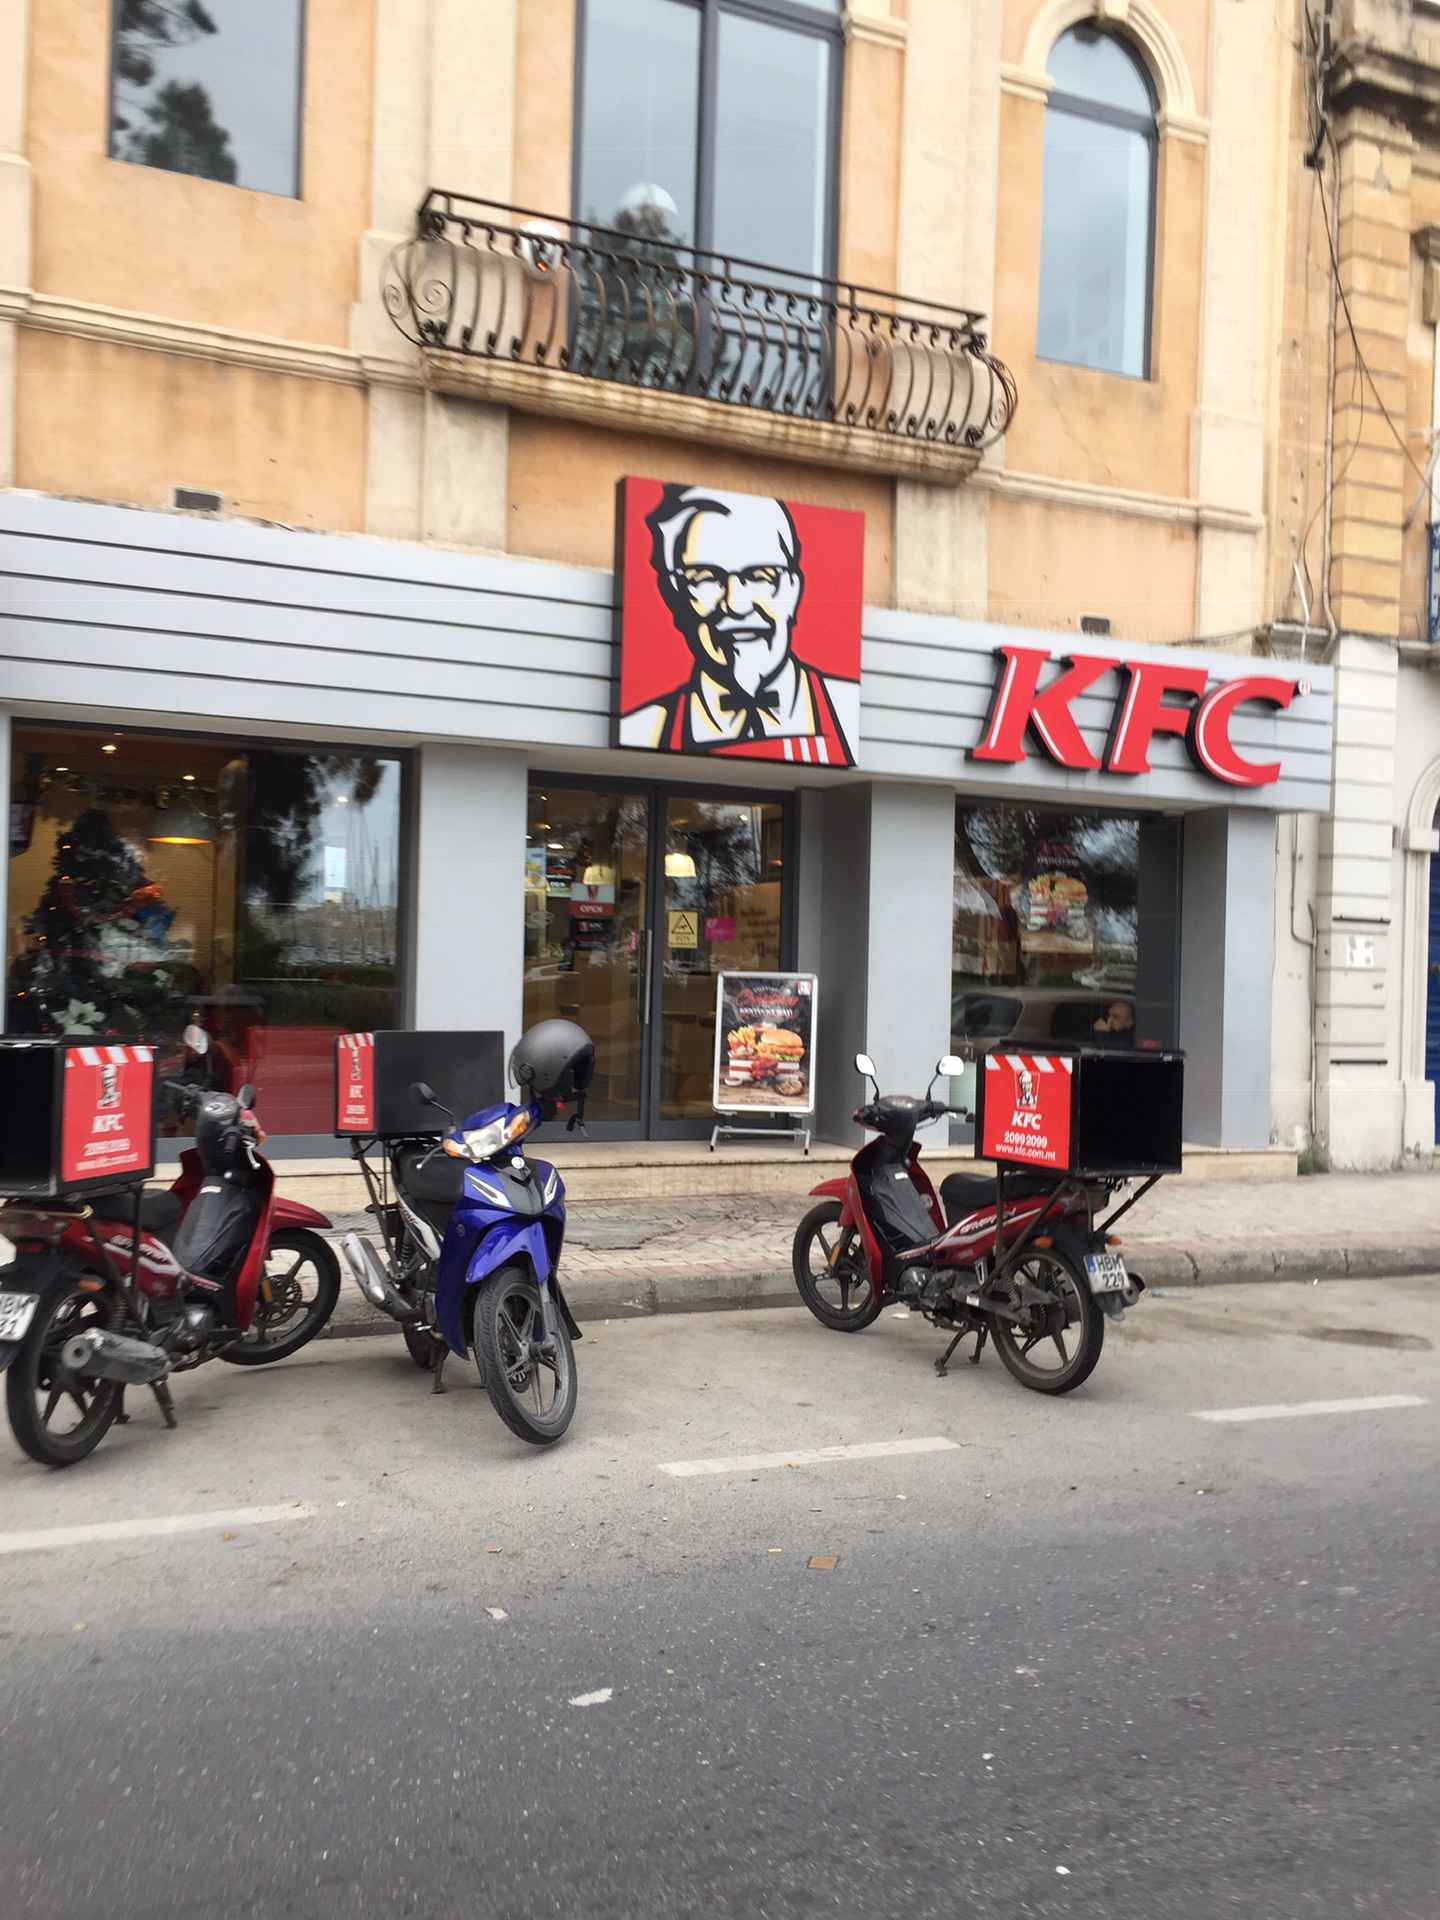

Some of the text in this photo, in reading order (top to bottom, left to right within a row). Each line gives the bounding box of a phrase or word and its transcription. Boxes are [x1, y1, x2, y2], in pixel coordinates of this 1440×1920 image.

[970, 646, 1296, 788] KFC
[1012, 1110, 1042, 1130] KFC
[995, 1143, 1056, 1161] www.kfc.com.mt
[1102, 1272, 1125, 1290] 229
